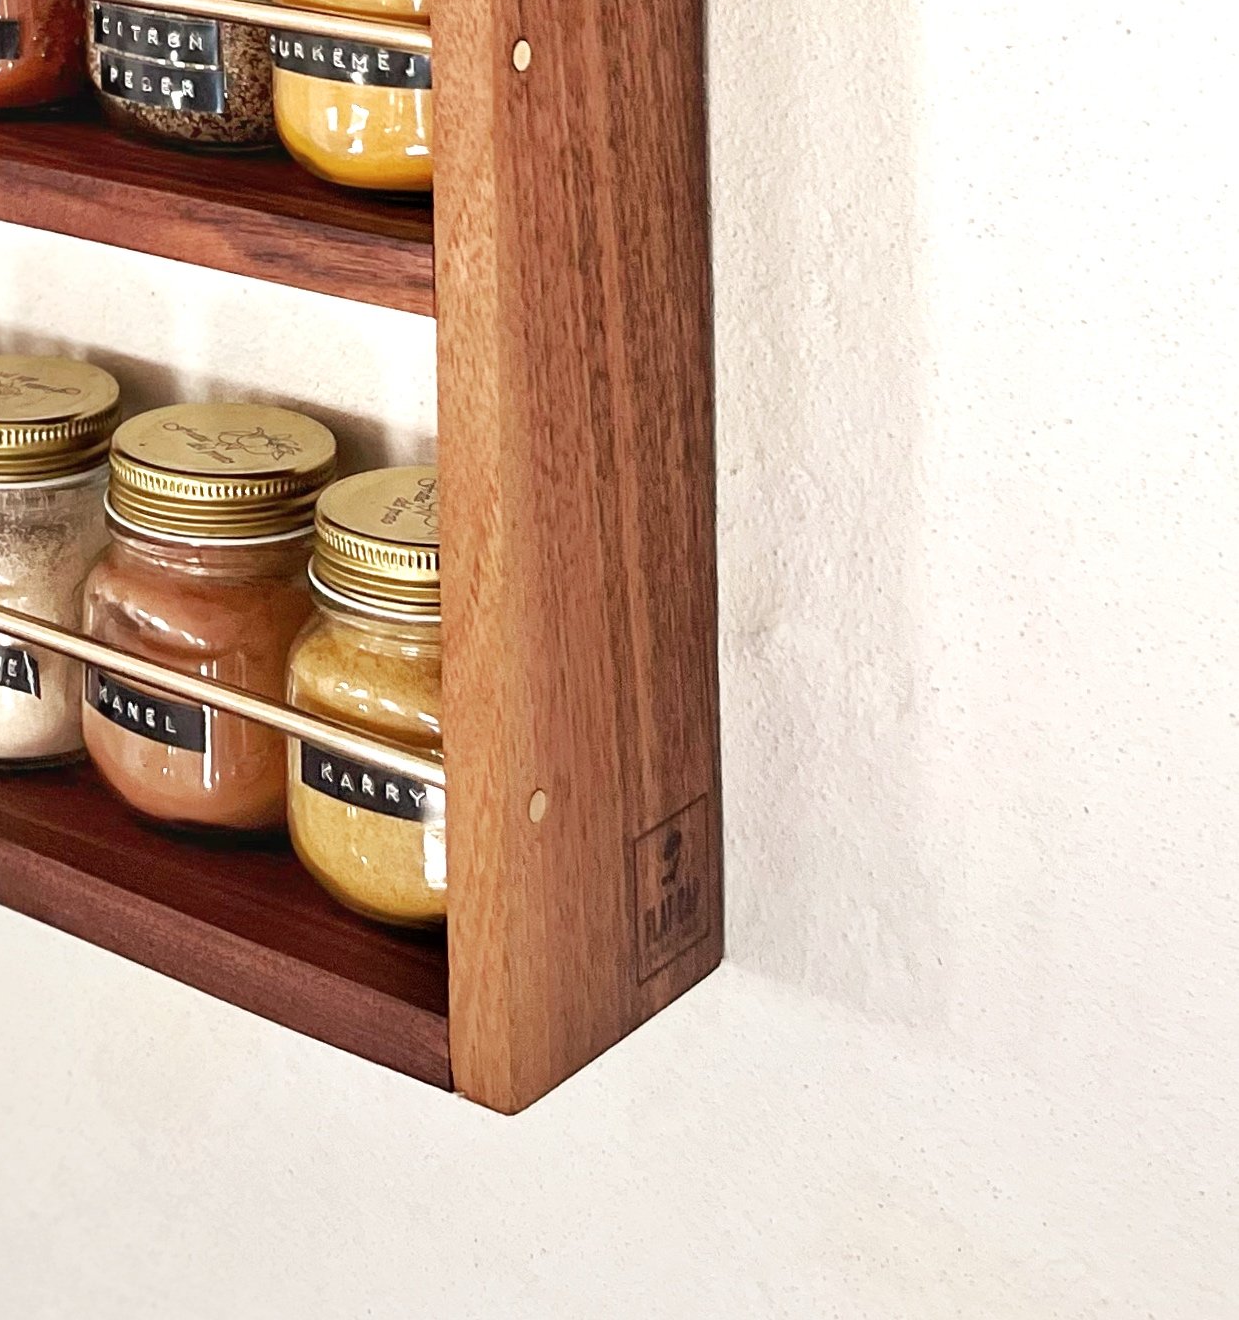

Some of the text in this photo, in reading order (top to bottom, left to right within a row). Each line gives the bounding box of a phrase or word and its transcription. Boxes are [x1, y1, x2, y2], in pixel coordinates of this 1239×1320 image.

[102, 15, 203, 52] CITRON
[110, 64, 194, 99] PEBER
[99, 682, 177, 734] KANEL
[321, 762, 426, 808] KARRY
